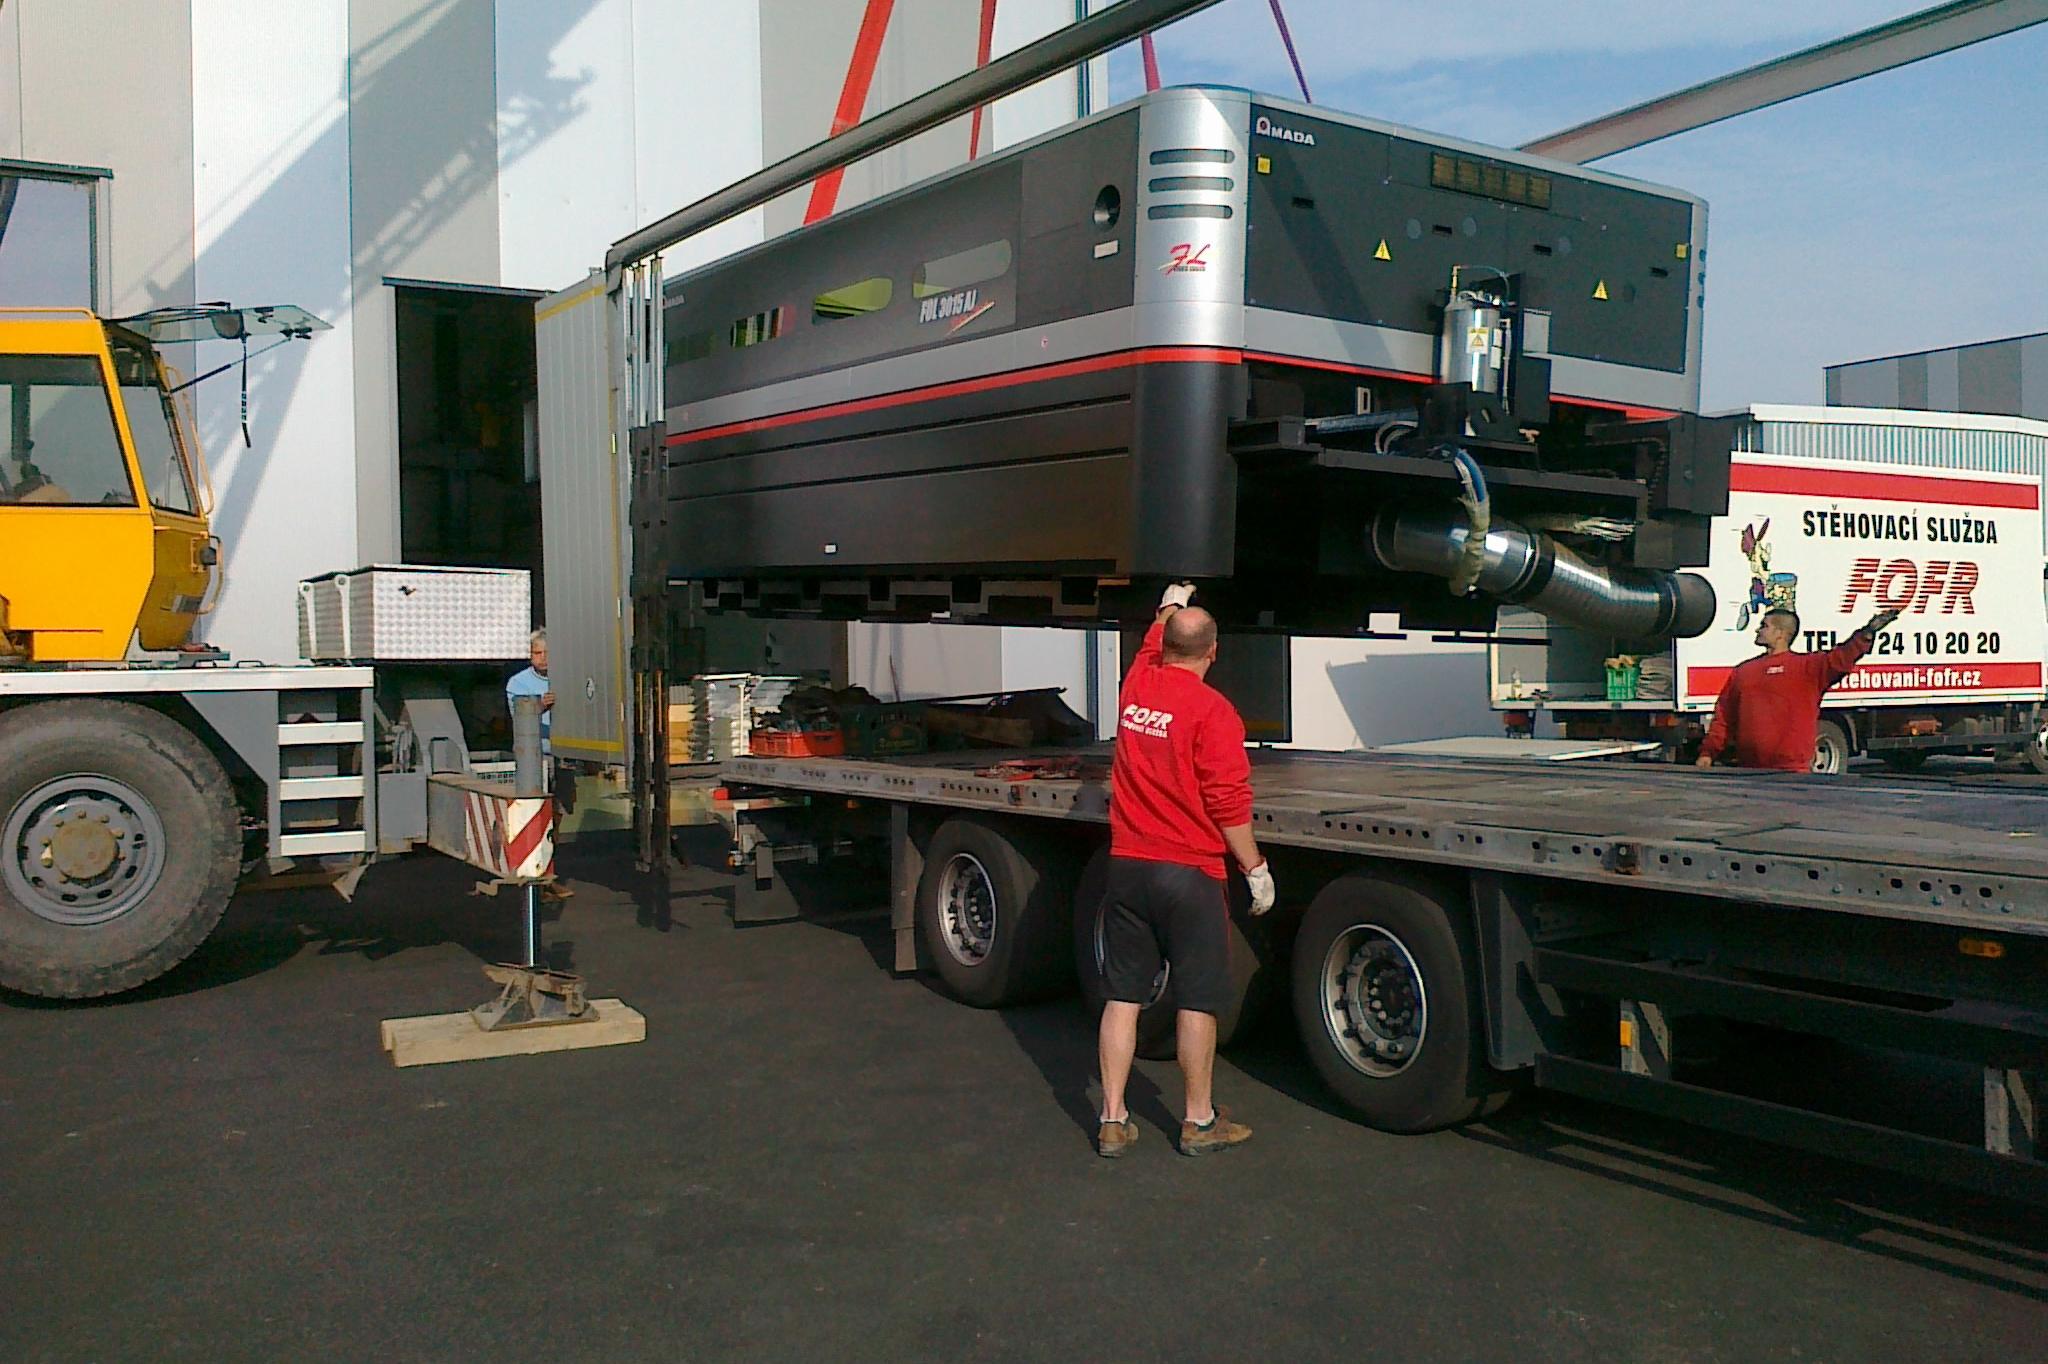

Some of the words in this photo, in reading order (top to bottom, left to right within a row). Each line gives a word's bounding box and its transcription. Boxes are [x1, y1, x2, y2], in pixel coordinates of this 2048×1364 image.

[1256, 116, 1315, 146] AMADA
[1803, 504, 1918, 541] STĚHOVACÍ
[1926, 511, 1998, 544] SLUŽBA
[1838, 558, 1979, 614] FOFR
[1867, 632, 1905, 655] 24
[1914, 632, 1938, 655] 10
[1945, 632, 1970, 655] 20
[1976, 632, 2001, 655] 20
